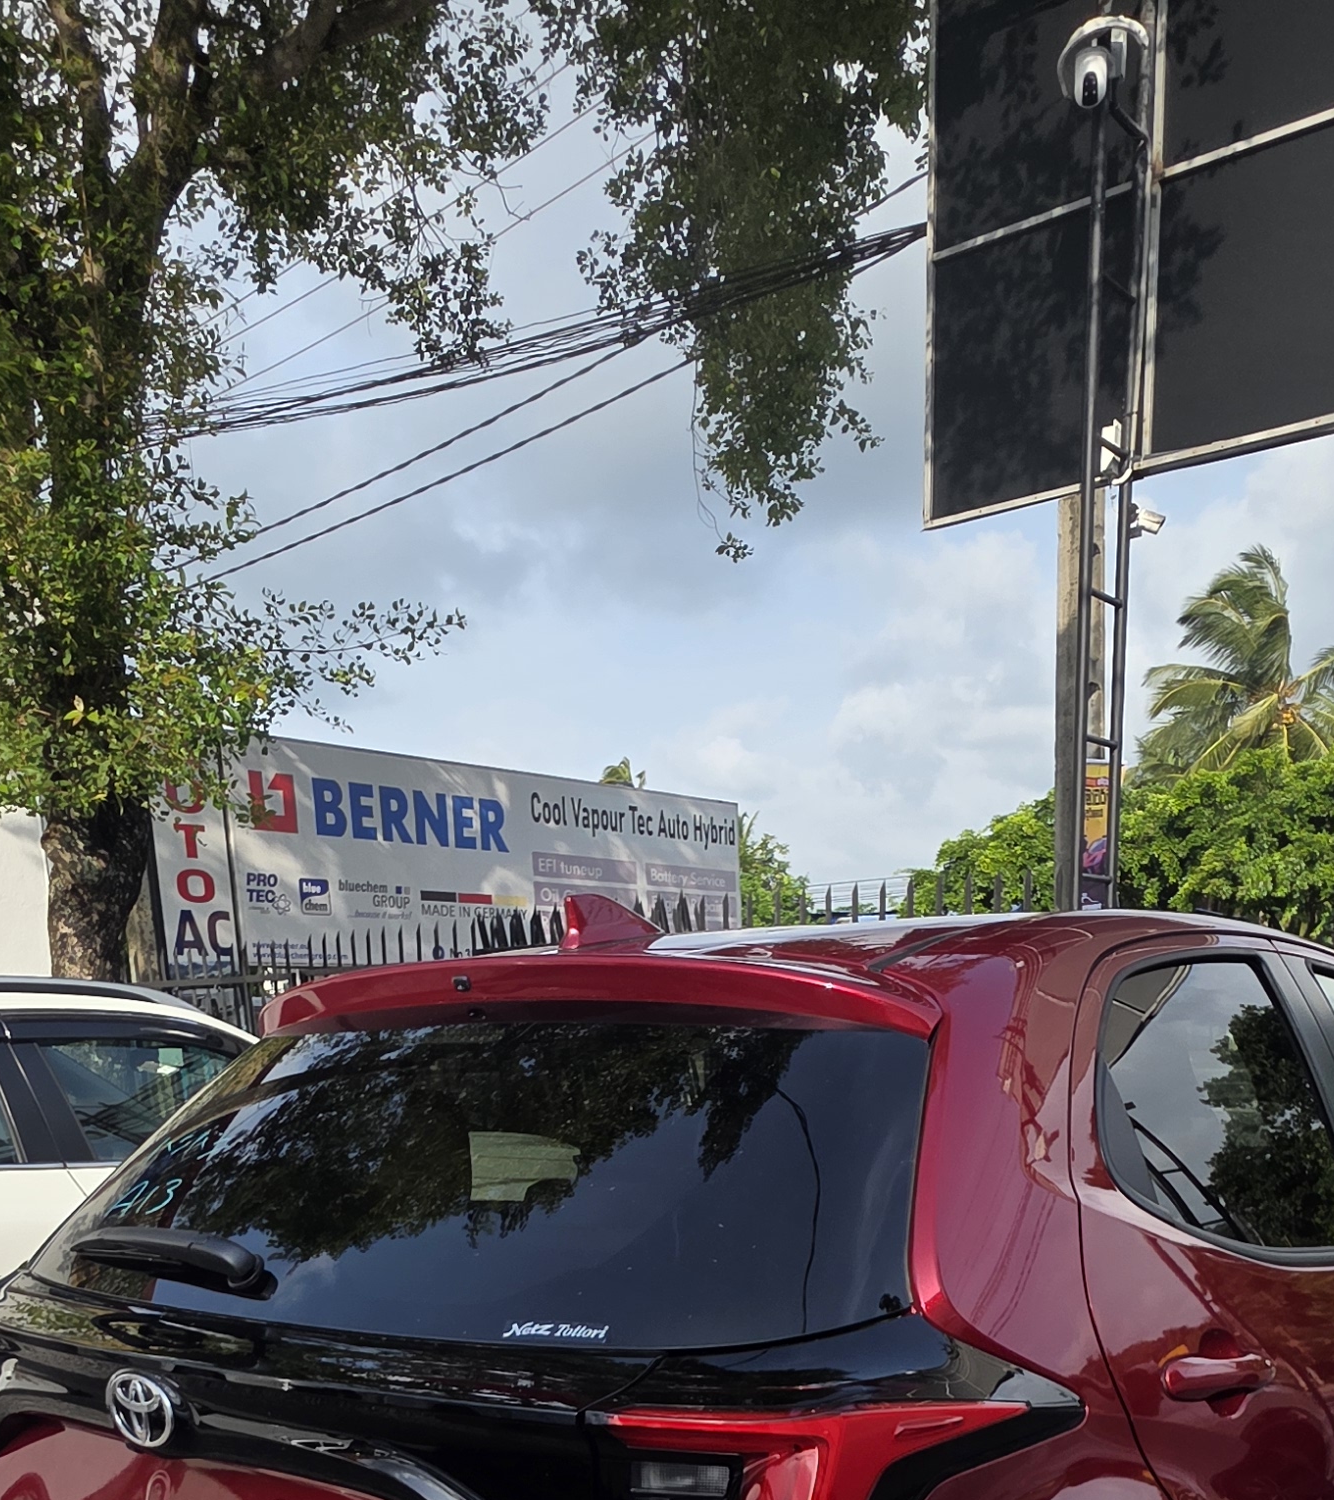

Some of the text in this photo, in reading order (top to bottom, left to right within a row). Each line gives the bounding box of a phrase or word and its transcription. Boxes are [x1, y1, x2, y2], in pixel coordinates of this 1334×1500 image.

[312, 777, 510, 853] BERNER
[531, 792, 735, 850] Cool Vapour Tec Auto Hybrid
[538, 858, 603, 879] EFI tuneup
[246, 872, 278, 888] PRO
[650, 867, 726, 888] Battery Service
[302, 882, 322, 894] blue
[338, 879, 388, 894] bluechem
[246, 888, 276, 903] TEC
[373, 894, 410, 909] GROUP
[304, 899, 328, 911] chem
[421, 903, 528, 920] MADE IN GERMAY
[175, 909, 234, 957] AC
